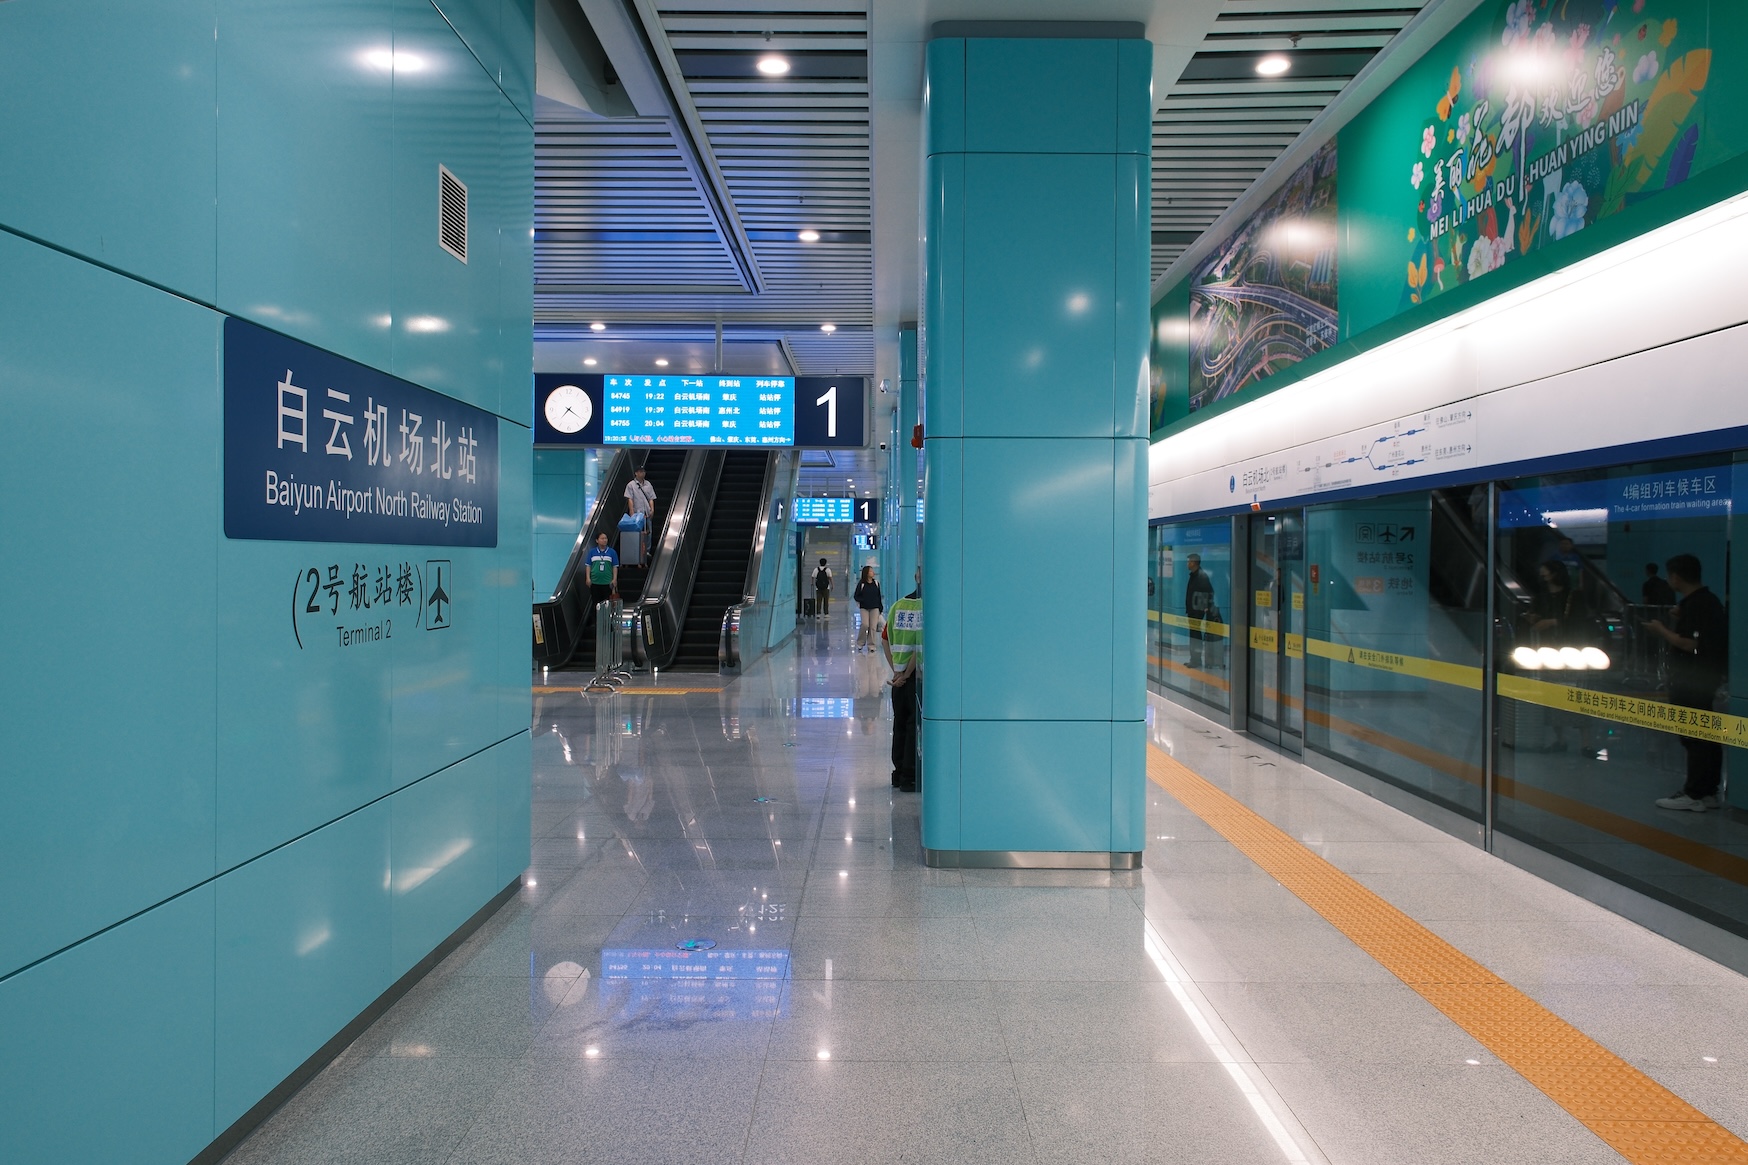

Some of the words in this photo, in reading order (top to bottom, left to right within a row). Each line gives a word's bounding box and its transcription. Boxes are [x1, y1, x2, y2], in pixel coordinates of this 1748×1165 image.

[1430, 214, 1449, 241] MEI
[1452, 204, 1464, 230] LI
[1467, 191, 1493, 220] HUA
[1496, 174, 1516, 203] DU
[1528, 143, 1569, 185] HUAN
[1569, 121, 1607, 160] YING
[1608, 100, 1640, 139] NIN
[674, 392, 710, 401] 白云机场南
[759, 393, 781, 402] 站站停
[645, 406, 665, 414] 19:39
[674, 406, 710, 415] 白云机场南
[759, 407, 781, 416] 站站停
[674, 419, 710, 428] 白云机场南
[759, 421, 781, 429] 站站停
[816, 386, 837, 438] 1
[277, 368, 478, 484] 白云机场北站
[266, 470, 323, 516] Baiyun
[326, 479, 373, 519] Airport
[375, 487, 408, 517] North
[411, 491, 452, 527] Railway
[452, 497, 483, 525] Station
[1622, 475, 1716, 500] 4编组列车候车区
[860, 501, 869, 521] 1
[1613, 504, 1625, 513] The
[1625, 503, 1640, 513] 4-car
[1641, 502, 1670, 512] formation
[1670, 500, 1686, 510] train
[1686, 498, 1711, 509] waiting
[336, 621, 384, 648] Terminal
[384, 618, 392, 639] 2
[1615, 713, 1629, 724] Height
[1629, 716, 1653, 727] Difference
[1653, 720, 1675, 730] Between
[1675, 725, 1688, 735] Train
[1688, 728, 1698, 737] and
[1722, 735, 1737, 745] Mind
